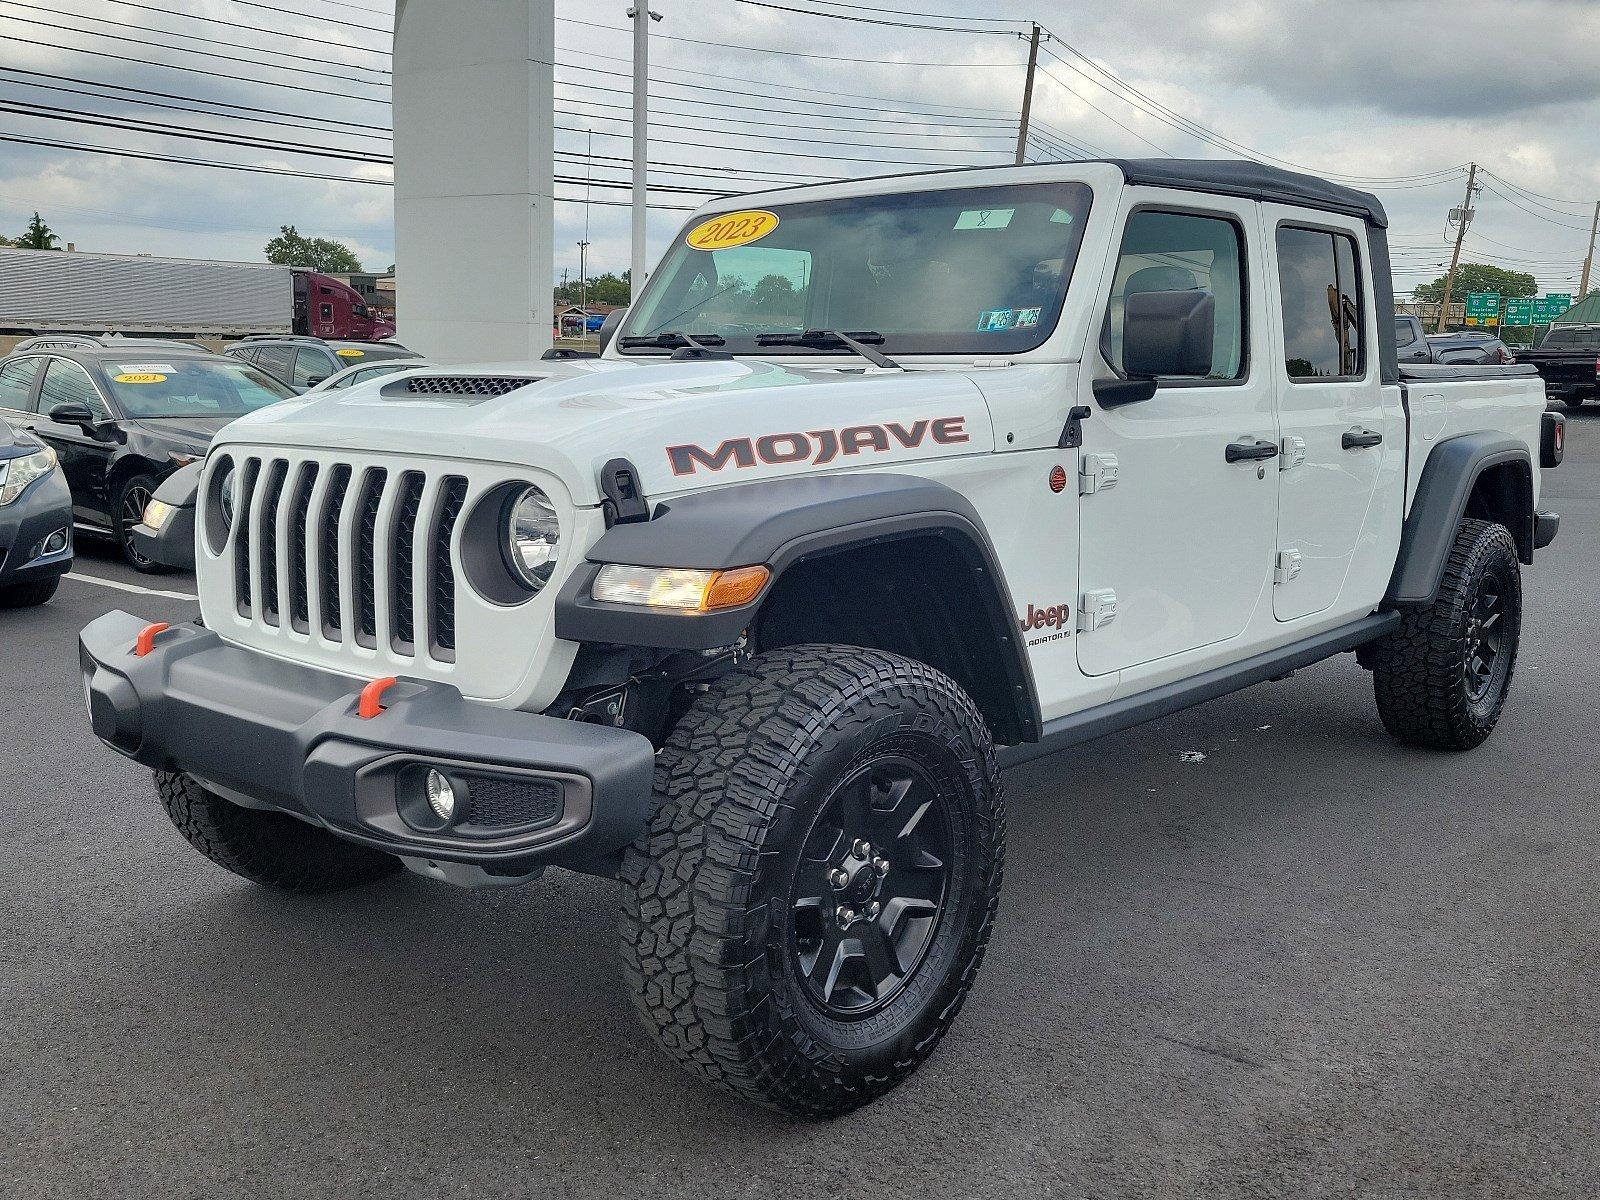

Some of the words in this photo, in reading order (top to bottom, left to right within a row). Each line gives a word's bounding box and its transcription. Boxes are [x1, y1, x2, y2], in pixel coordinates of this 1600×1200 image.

[697, 216, 767, 245] 2023
[124, 374, 158, 382] 2021
[664, 415, 971, 477] MOJAVE
[1019, 603, 1070, 631] Jeep
[1027, 632, 1063, 648] ADIATOR
